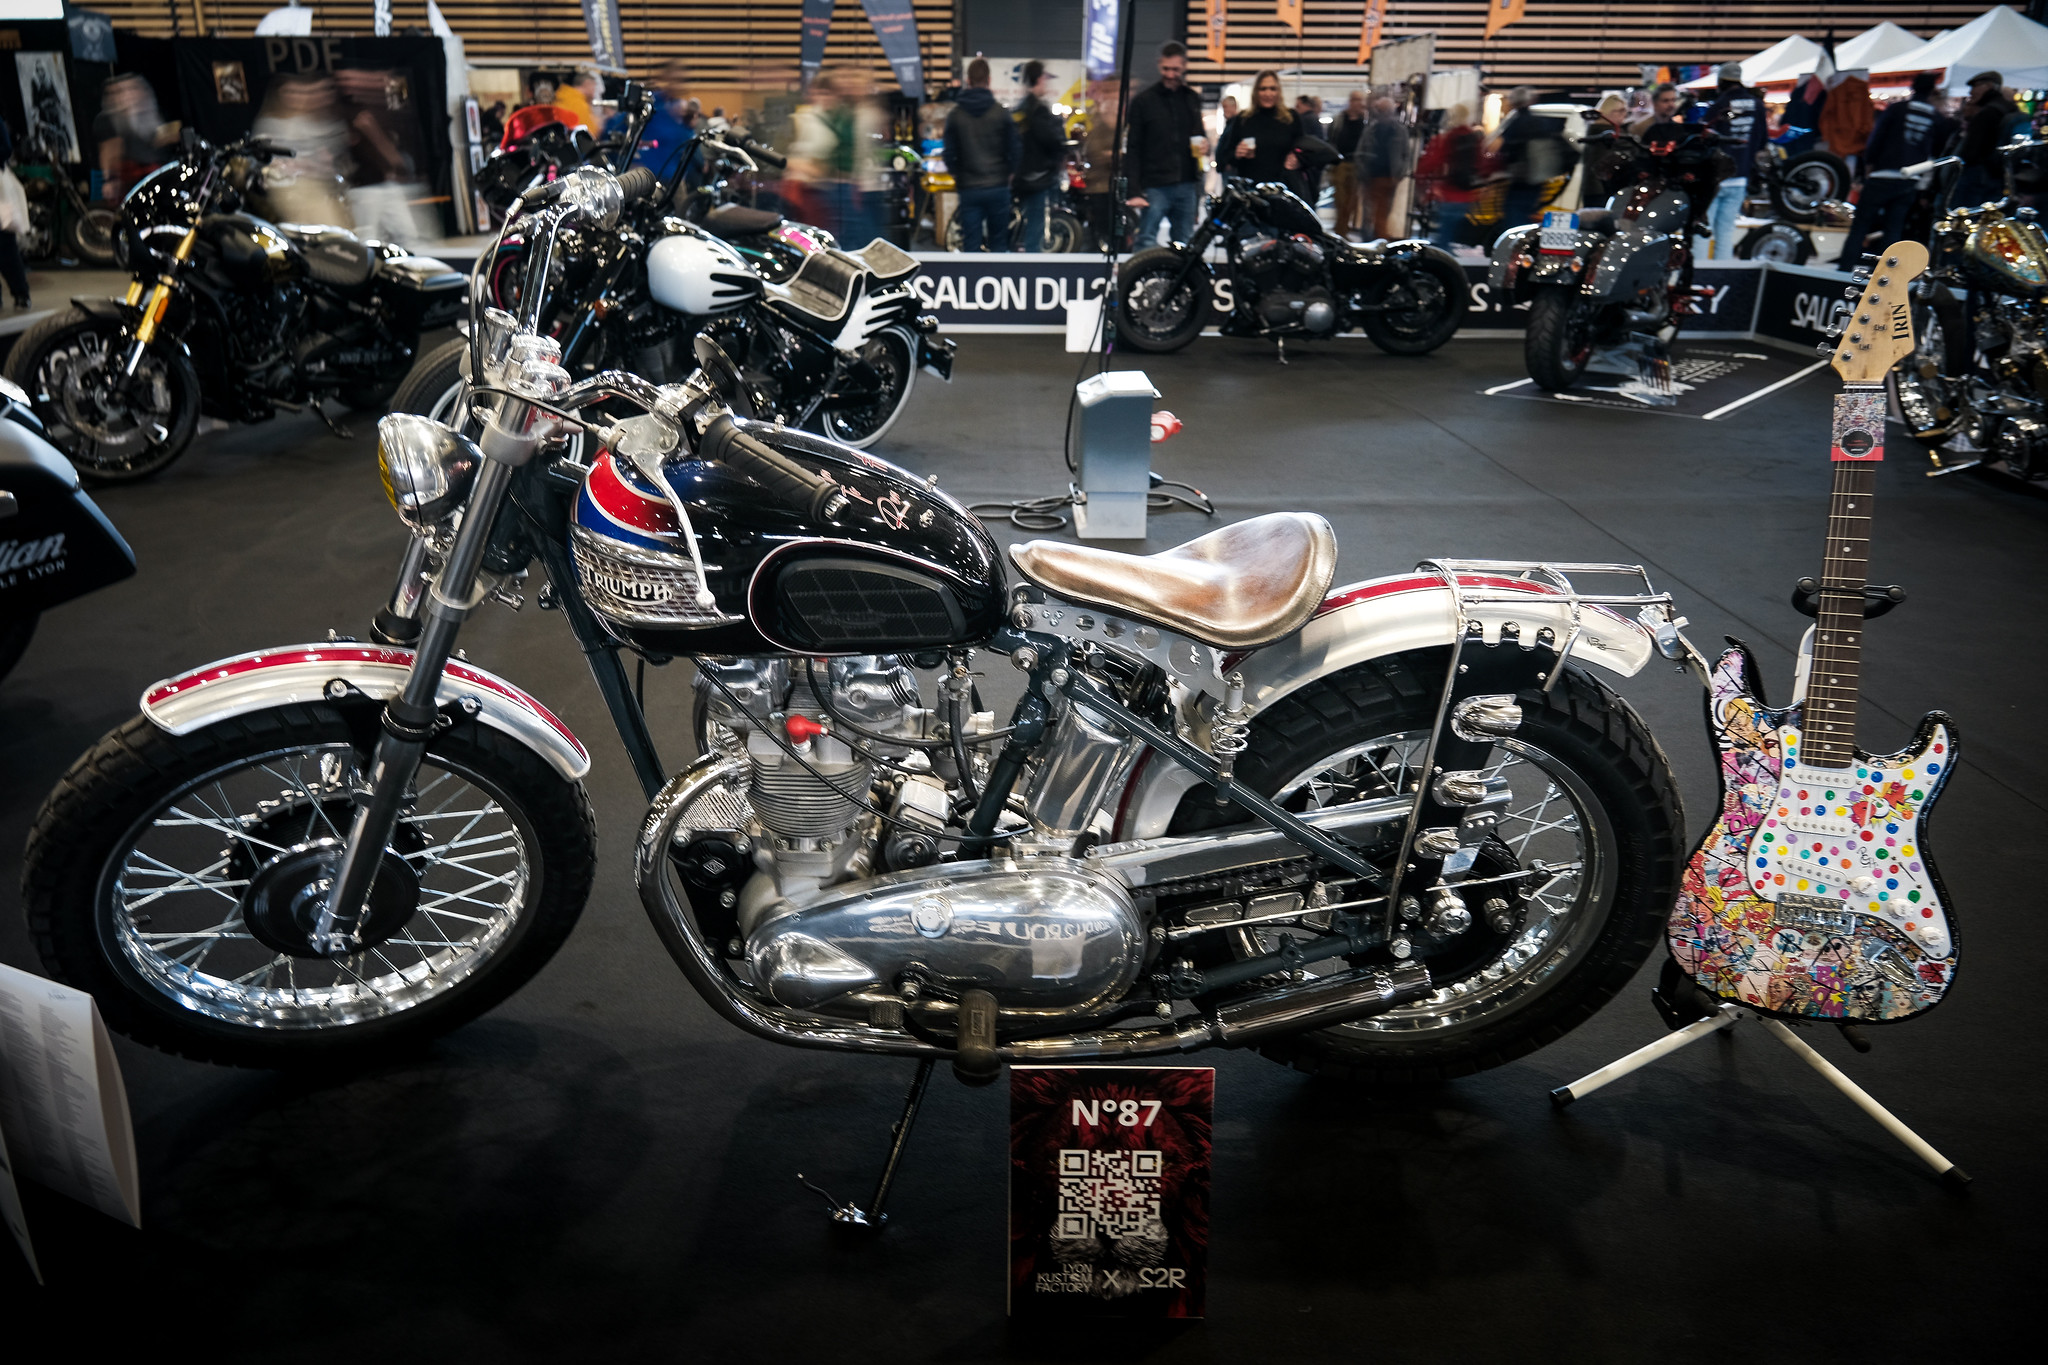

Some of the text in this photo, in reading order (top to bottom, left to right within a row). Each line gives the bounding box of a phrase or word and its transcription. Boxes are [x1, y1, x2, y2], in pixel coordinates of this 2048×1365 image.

[912, 275, 1027, 311] SALON
[1892, 303, 1910, 341] IRIN
[584, 563, 671, 602] TRIUMPH
[1072, 1100, 1162, 1127] N°87
